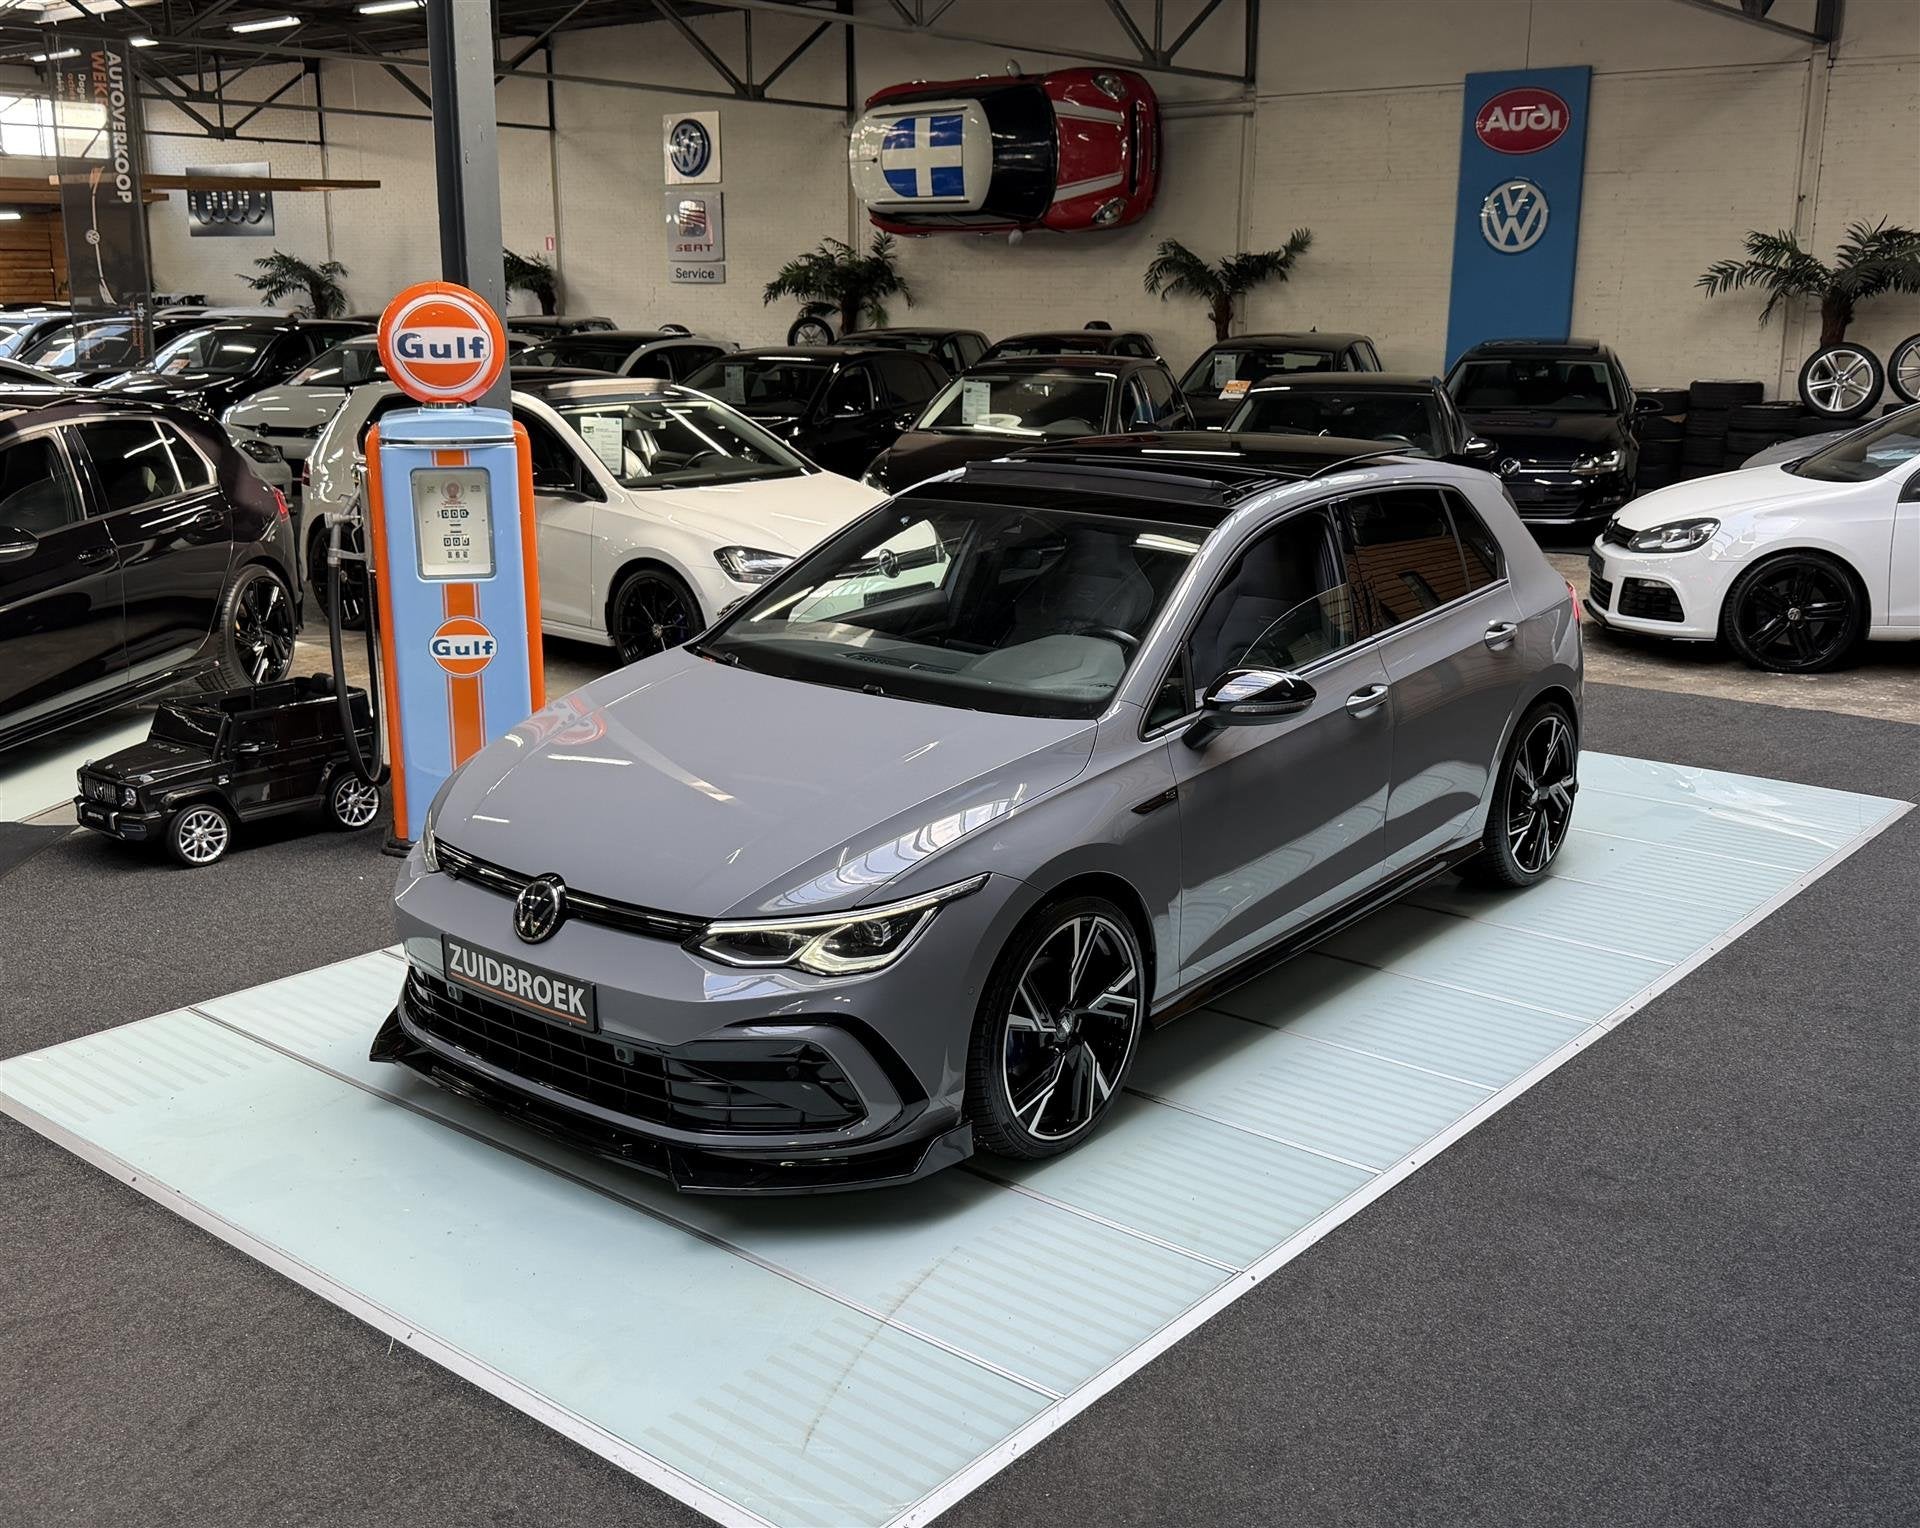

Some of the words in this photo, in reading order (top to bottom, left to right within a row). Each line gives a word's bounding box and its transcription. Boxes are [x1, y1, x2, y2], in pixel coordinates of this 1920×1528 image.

[106, 51, 133, 204] AUTOVERKOOP
[675, 243, 714, 252] SEAT
[675, 267, 715, 279] Service
[397, 332, 484, 358] Gulf
[432, 639, 493, 655] Gulf
[448, 943, 587, 1017] ZUIDBROEK
